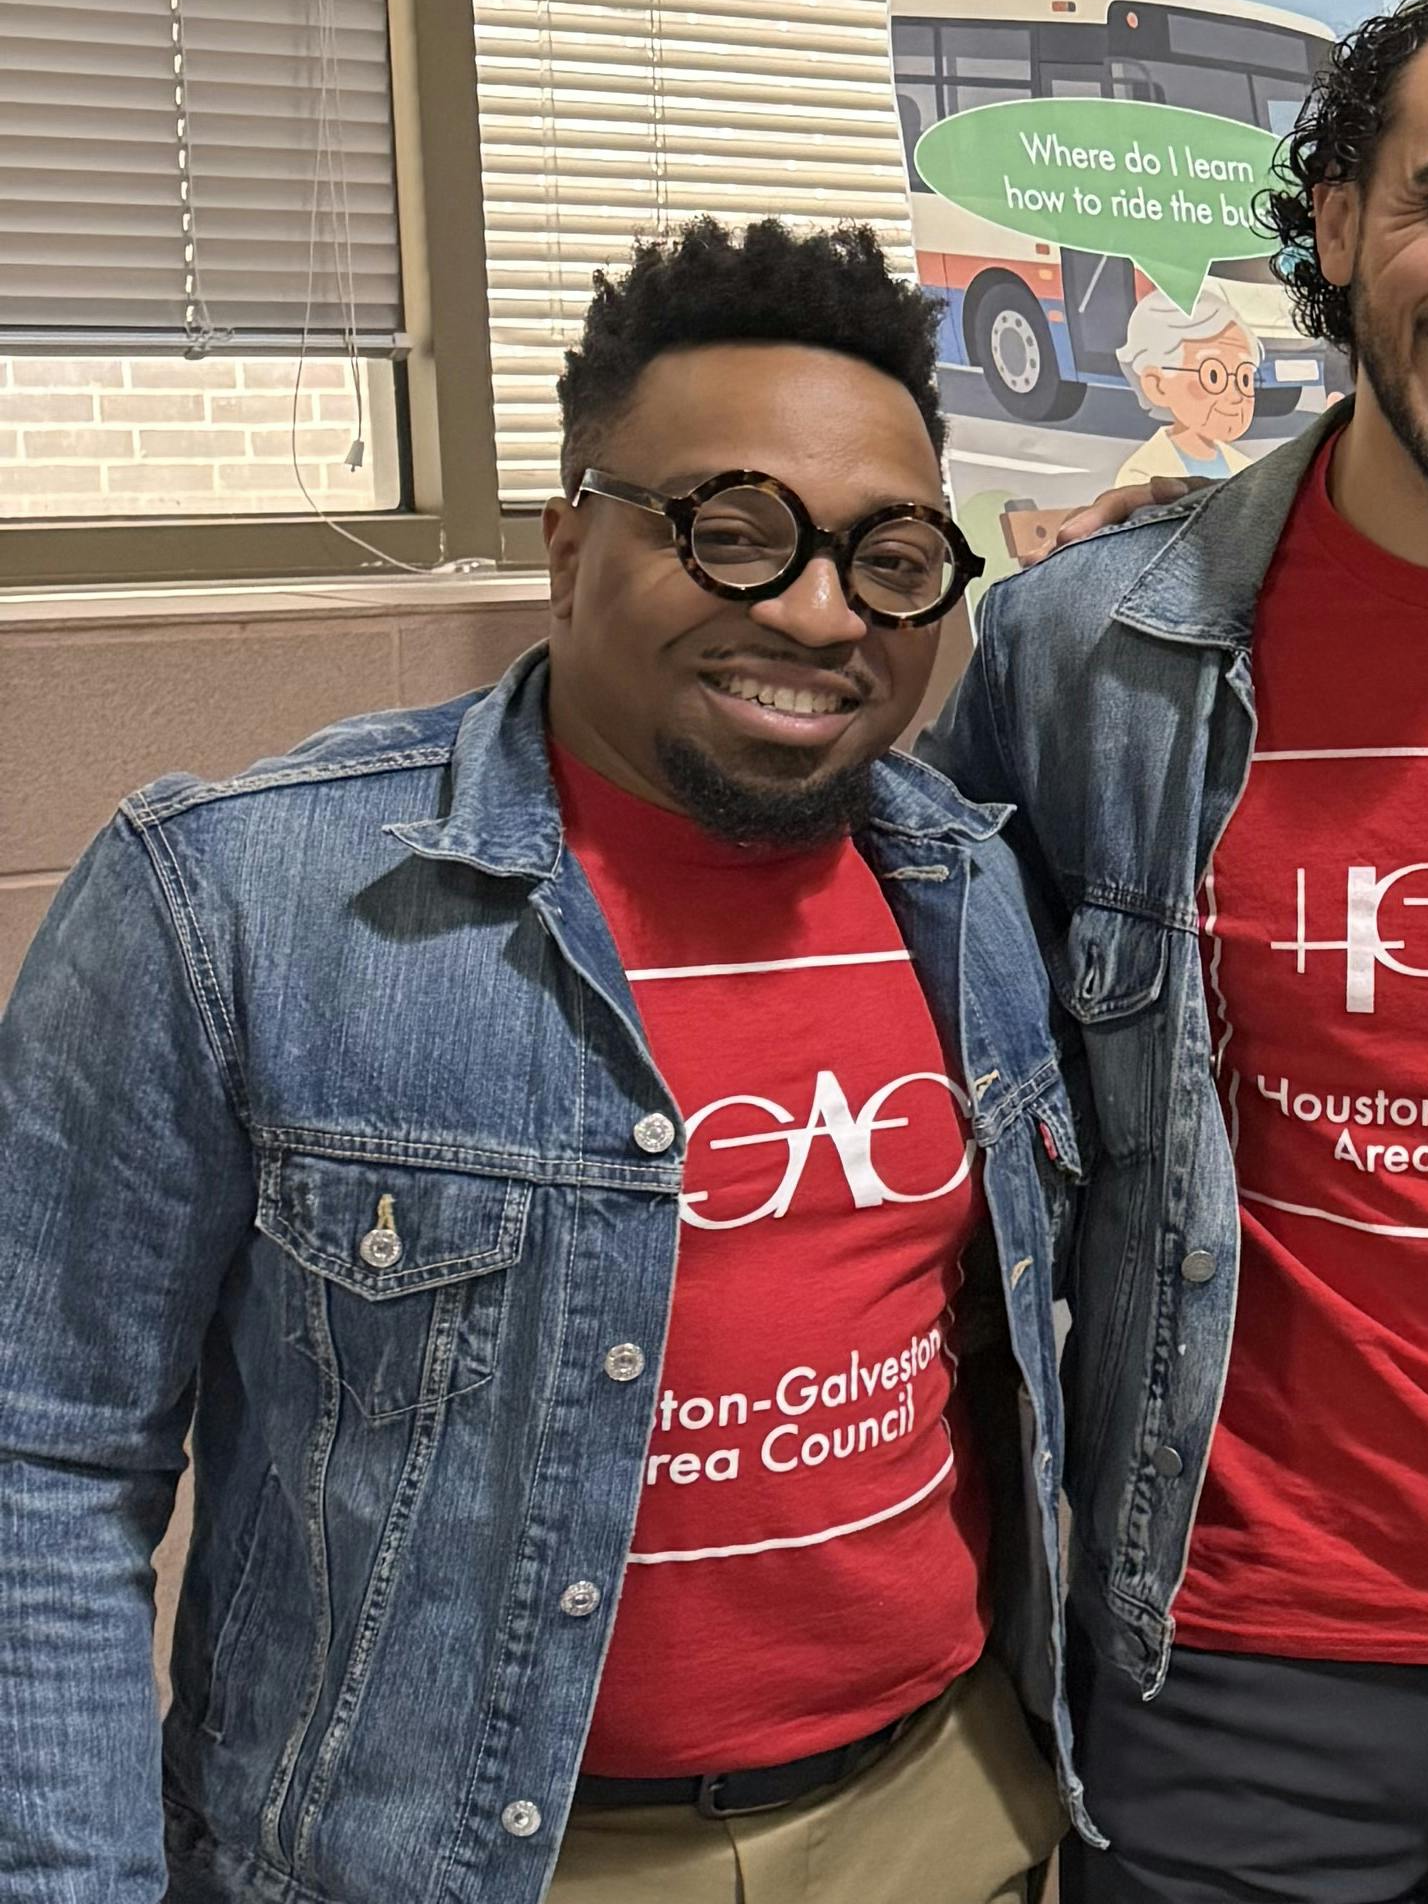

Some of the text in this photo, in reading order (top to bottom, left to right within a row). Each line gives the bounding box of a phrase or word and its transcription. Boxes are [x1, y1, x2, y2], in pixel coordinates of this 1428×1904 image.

[1003, 175, 1065, 214] how
[1073, 186, 1102, 216] to
[1111, 186, 1164, 221] ride
[1169, 189, 1213, 225] the
[1019, 131, 1255, 183] Where do I learn
[680, 1069, 977, 1230] GAC
[650, 1327, 941, 1432] ton-Galveston
[646, 1382, 916, 1486] rea Council
